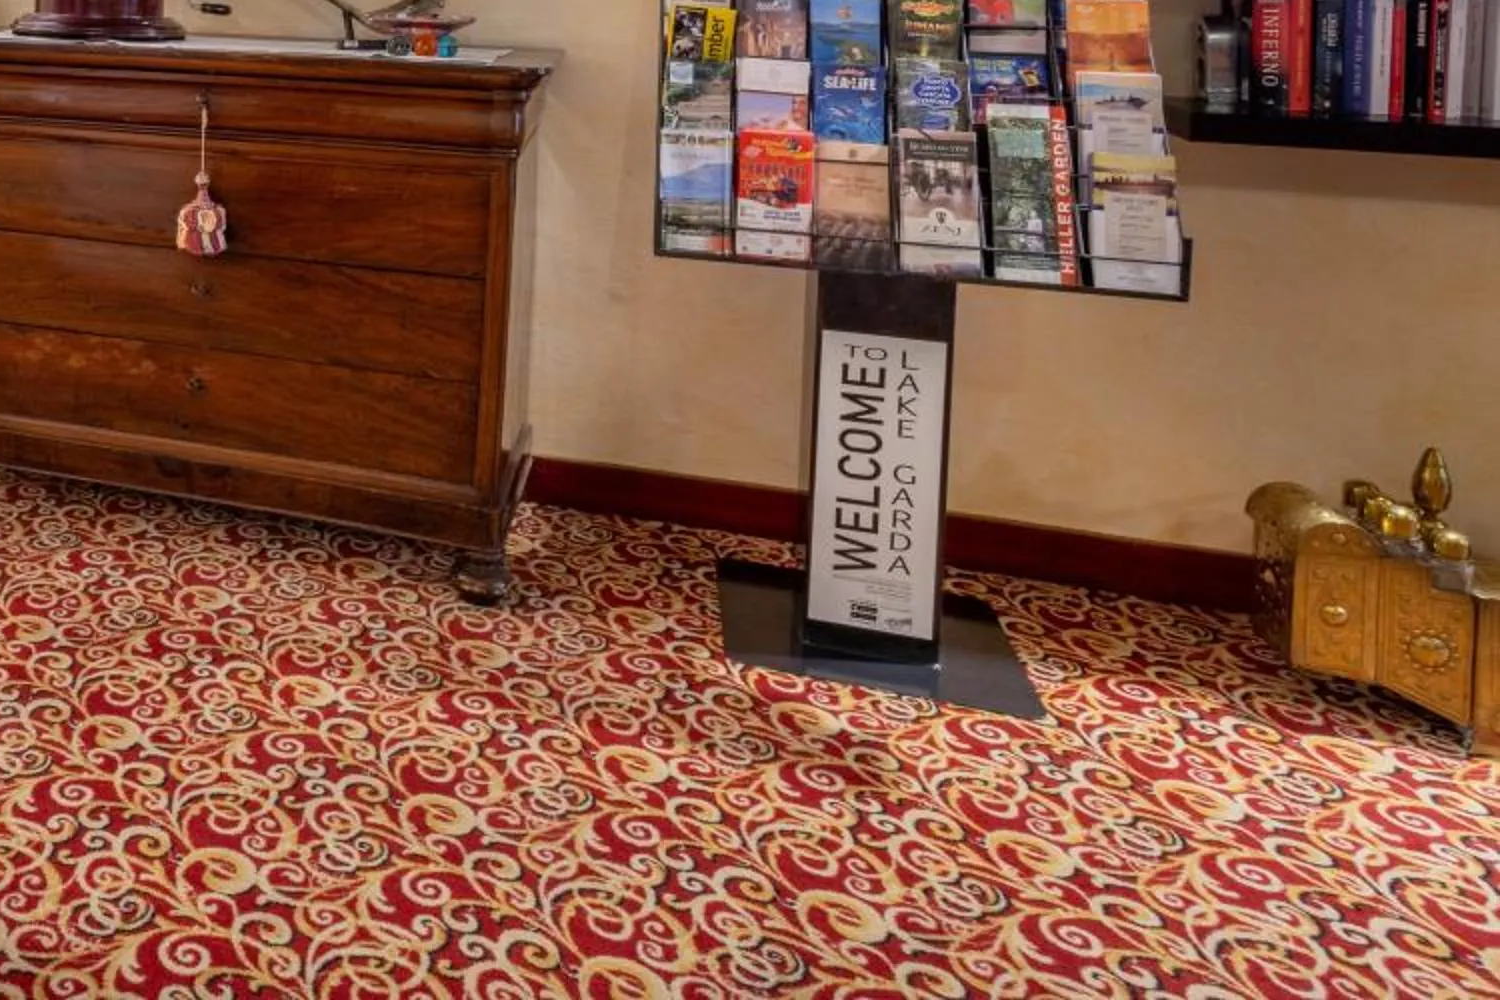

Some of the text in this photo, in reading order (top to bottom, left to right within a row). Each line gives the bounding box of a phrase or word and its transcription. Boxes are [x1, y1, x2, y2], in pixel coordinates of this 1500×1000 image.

[852, 76, 877, 91] LIFE
[1261, 9, 1280, 87] INFERNO
[1052, 118, 1076, 275] HELLER GARDEN
[843, 343, 888, 361] TO
[897, 348, 921, 440] LAKE
[832, 362, 887, 571] WELCOME
[888, 464, 916, 577] GARDA
